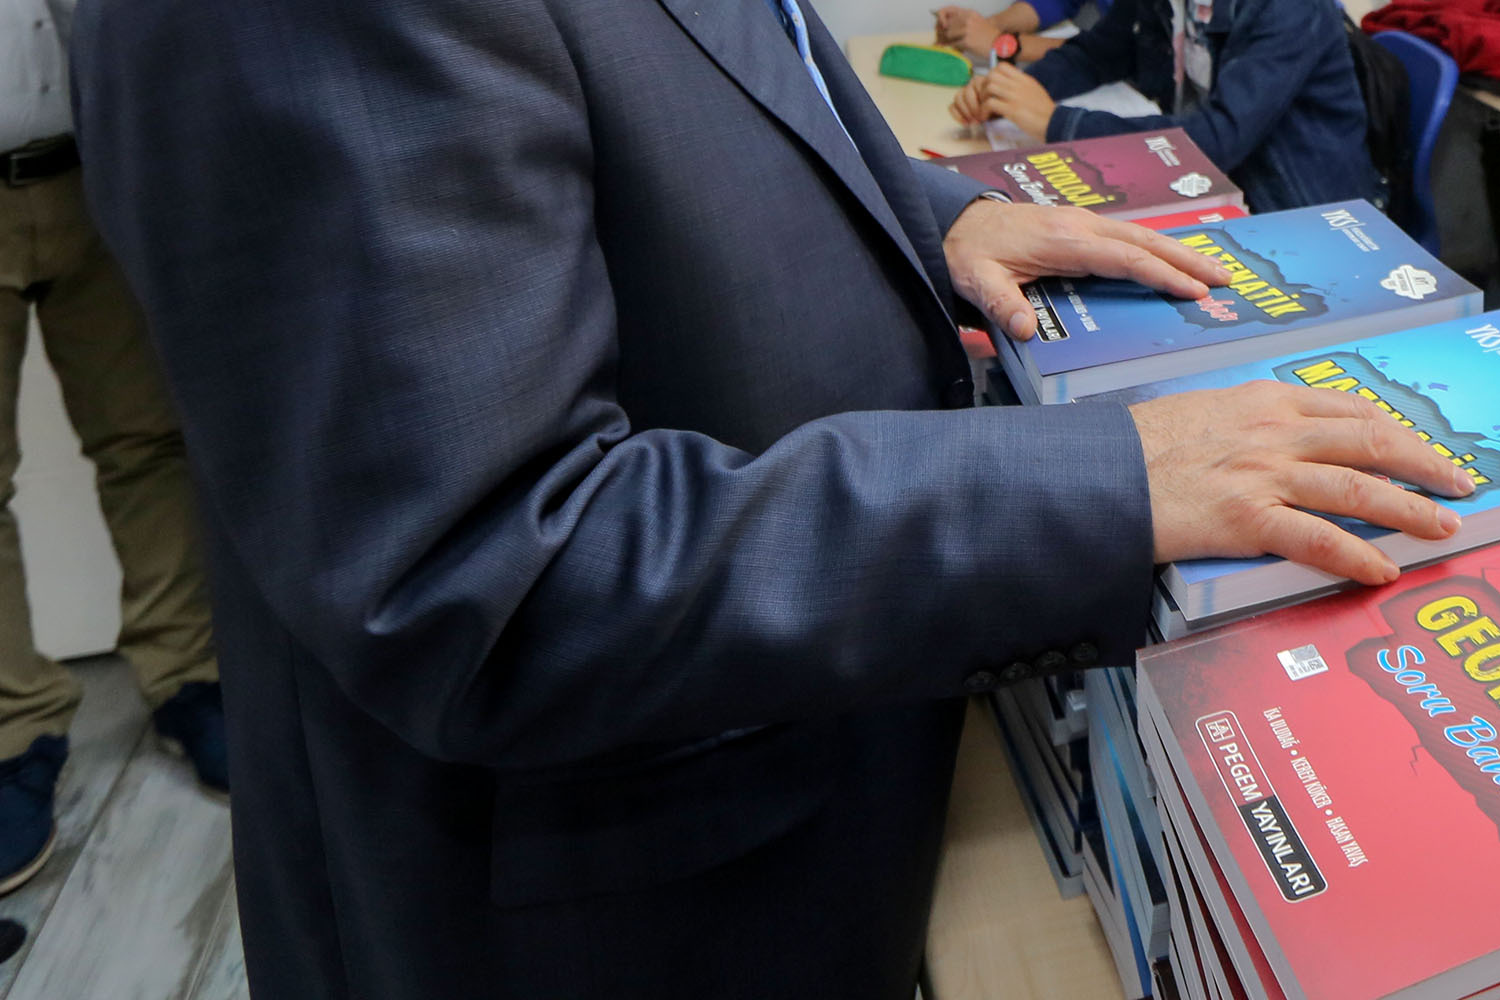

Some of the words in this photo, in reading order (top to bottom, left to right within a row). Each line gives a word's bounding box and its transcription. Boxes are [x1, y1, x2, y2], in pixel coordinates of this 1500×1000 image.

[1377, 645, 1457, 718] Soru
[1290, 756, 1319, 785] KEREM
[1304, 780, 1333, 809] KÖKER
[1218, 742, 1264, 802] PEGEM
[1251, 801, 1315, 896] YAYINLARI
[1325, 816, 1354, 845] HASAN
[1340, 838, 1369, 868] YAVAŞ
